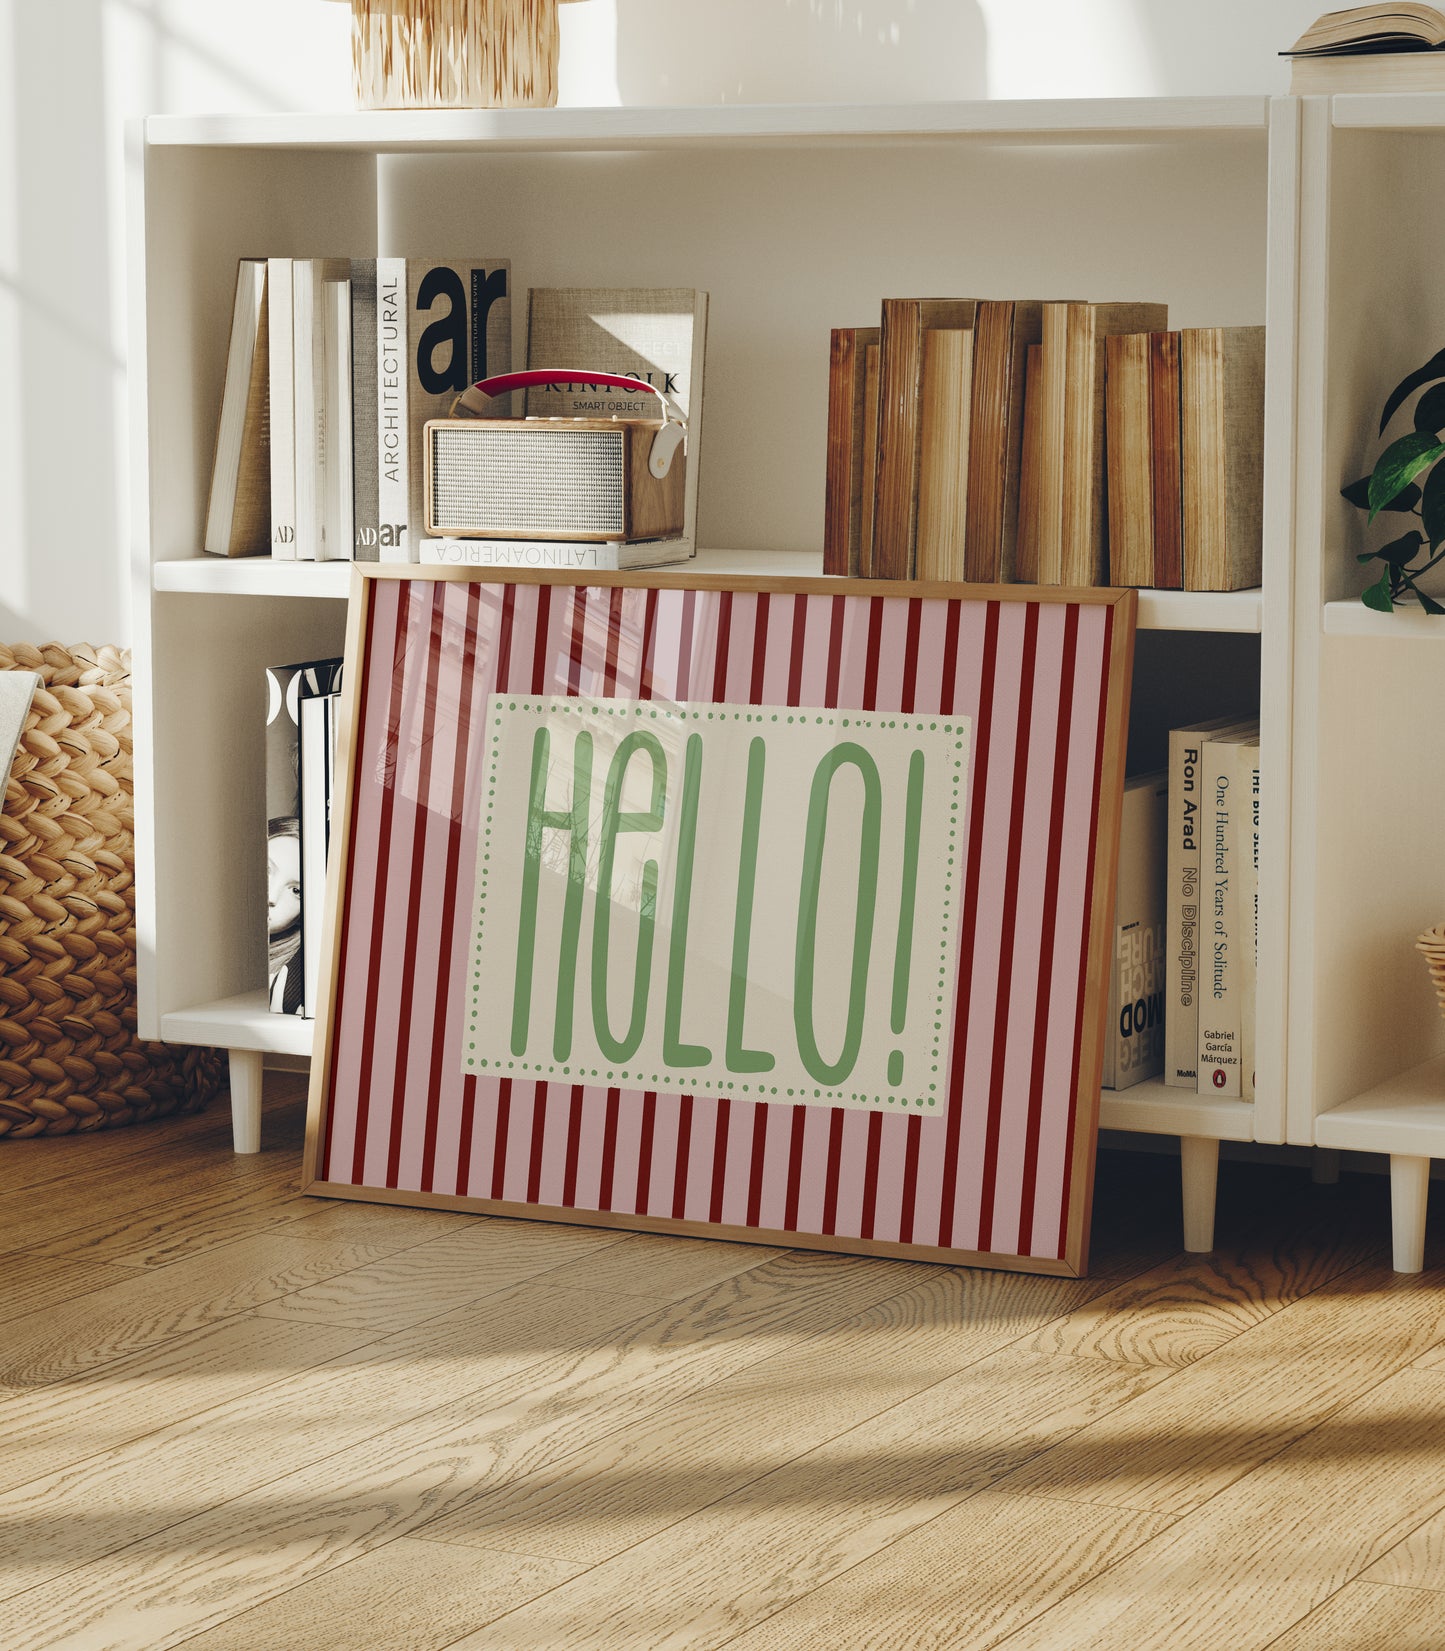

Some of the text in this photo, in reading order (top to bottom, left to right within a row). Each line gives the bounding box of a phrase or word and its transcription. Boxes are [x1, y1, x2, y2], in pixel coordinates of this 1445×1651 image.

[416, 267, 506, 395] ar
[382, 277, 399, 483] ARCHITECTURAL
[573, 401, 646, 412] SMART OBJECT
[274, 526, 294, 543] AD
[356, 527, 378, 546] AD
[380, 523, 407, 546] ar
[435, 545, 597, 566] LATINOAMERICA
[1182, 748, 1198, 850] Ron Arad
[1213, 775, 1230, 999] One Hundred Years of Solitude
[1178, 867, 1197, 1007] No Discipline
[1119, 991, 1163, 1038] MOD
[1203, 1030, 1235, 1041] Gabriel
[1205, 1042, 1232, 1052] García
[1200, 1054, 1238, 1066] Márquez
[1176, 1070, 1197, 1079] MoMA
